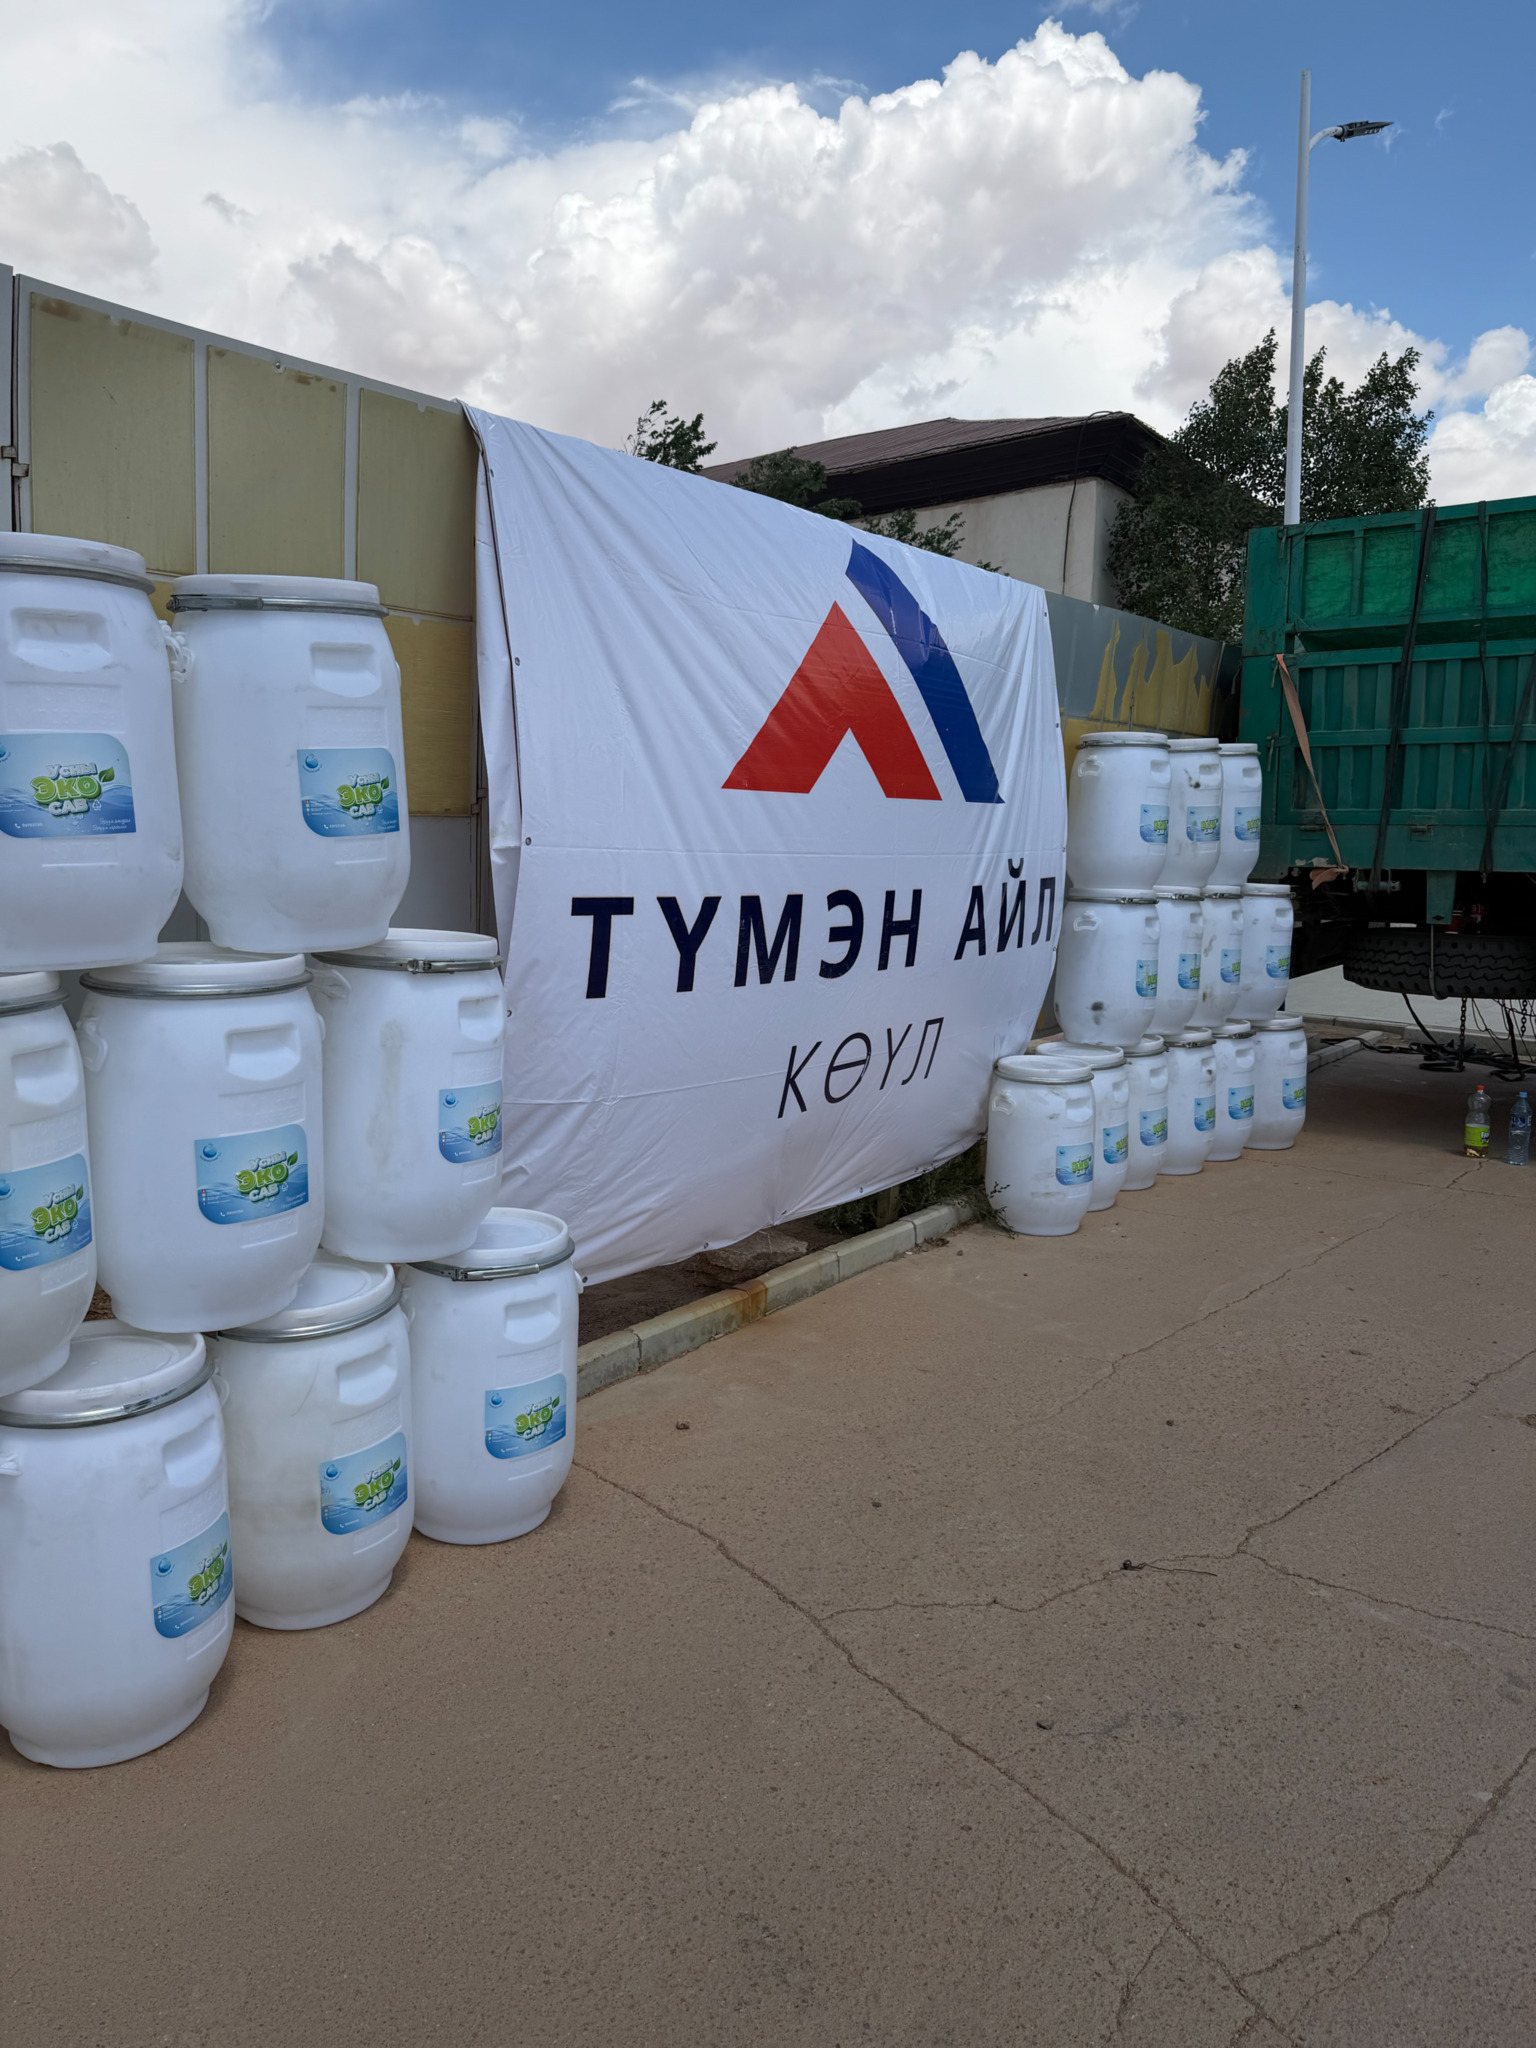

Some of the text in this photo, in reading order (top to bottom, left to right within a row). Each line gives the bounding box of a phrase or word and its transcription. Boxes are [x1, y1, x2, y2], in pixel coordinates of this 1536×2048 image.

[30, 776, 102, 805] ЭКО
[336, 784, 383, 809] ЭКО
[48, 799, 91, 817] САВ
[349, 803, 376, 819] САВ
[571, 857, 1057, 999] ТҮМЭН АЙЛ
[777, 1017, 944, 1119] КӨҮЛ
[467, 1113, 497, 1139] ЭКО
[235, 1163, 289, 1195] ЭКО
[249, 1183, 280, 1203] САВ
[30, 1198, 78, 1235] ЭКО
[44, 1220, 72, 1244] САВ
[514, 1407, 552, 1436] ЭКО
[523, 1424, 546, 1441] САВ
[354, 1471, 394, 1507] ЭКО
[364, 1492, 388, 1512] САВ
[188, 1557, 224, 1602] ЭКО
